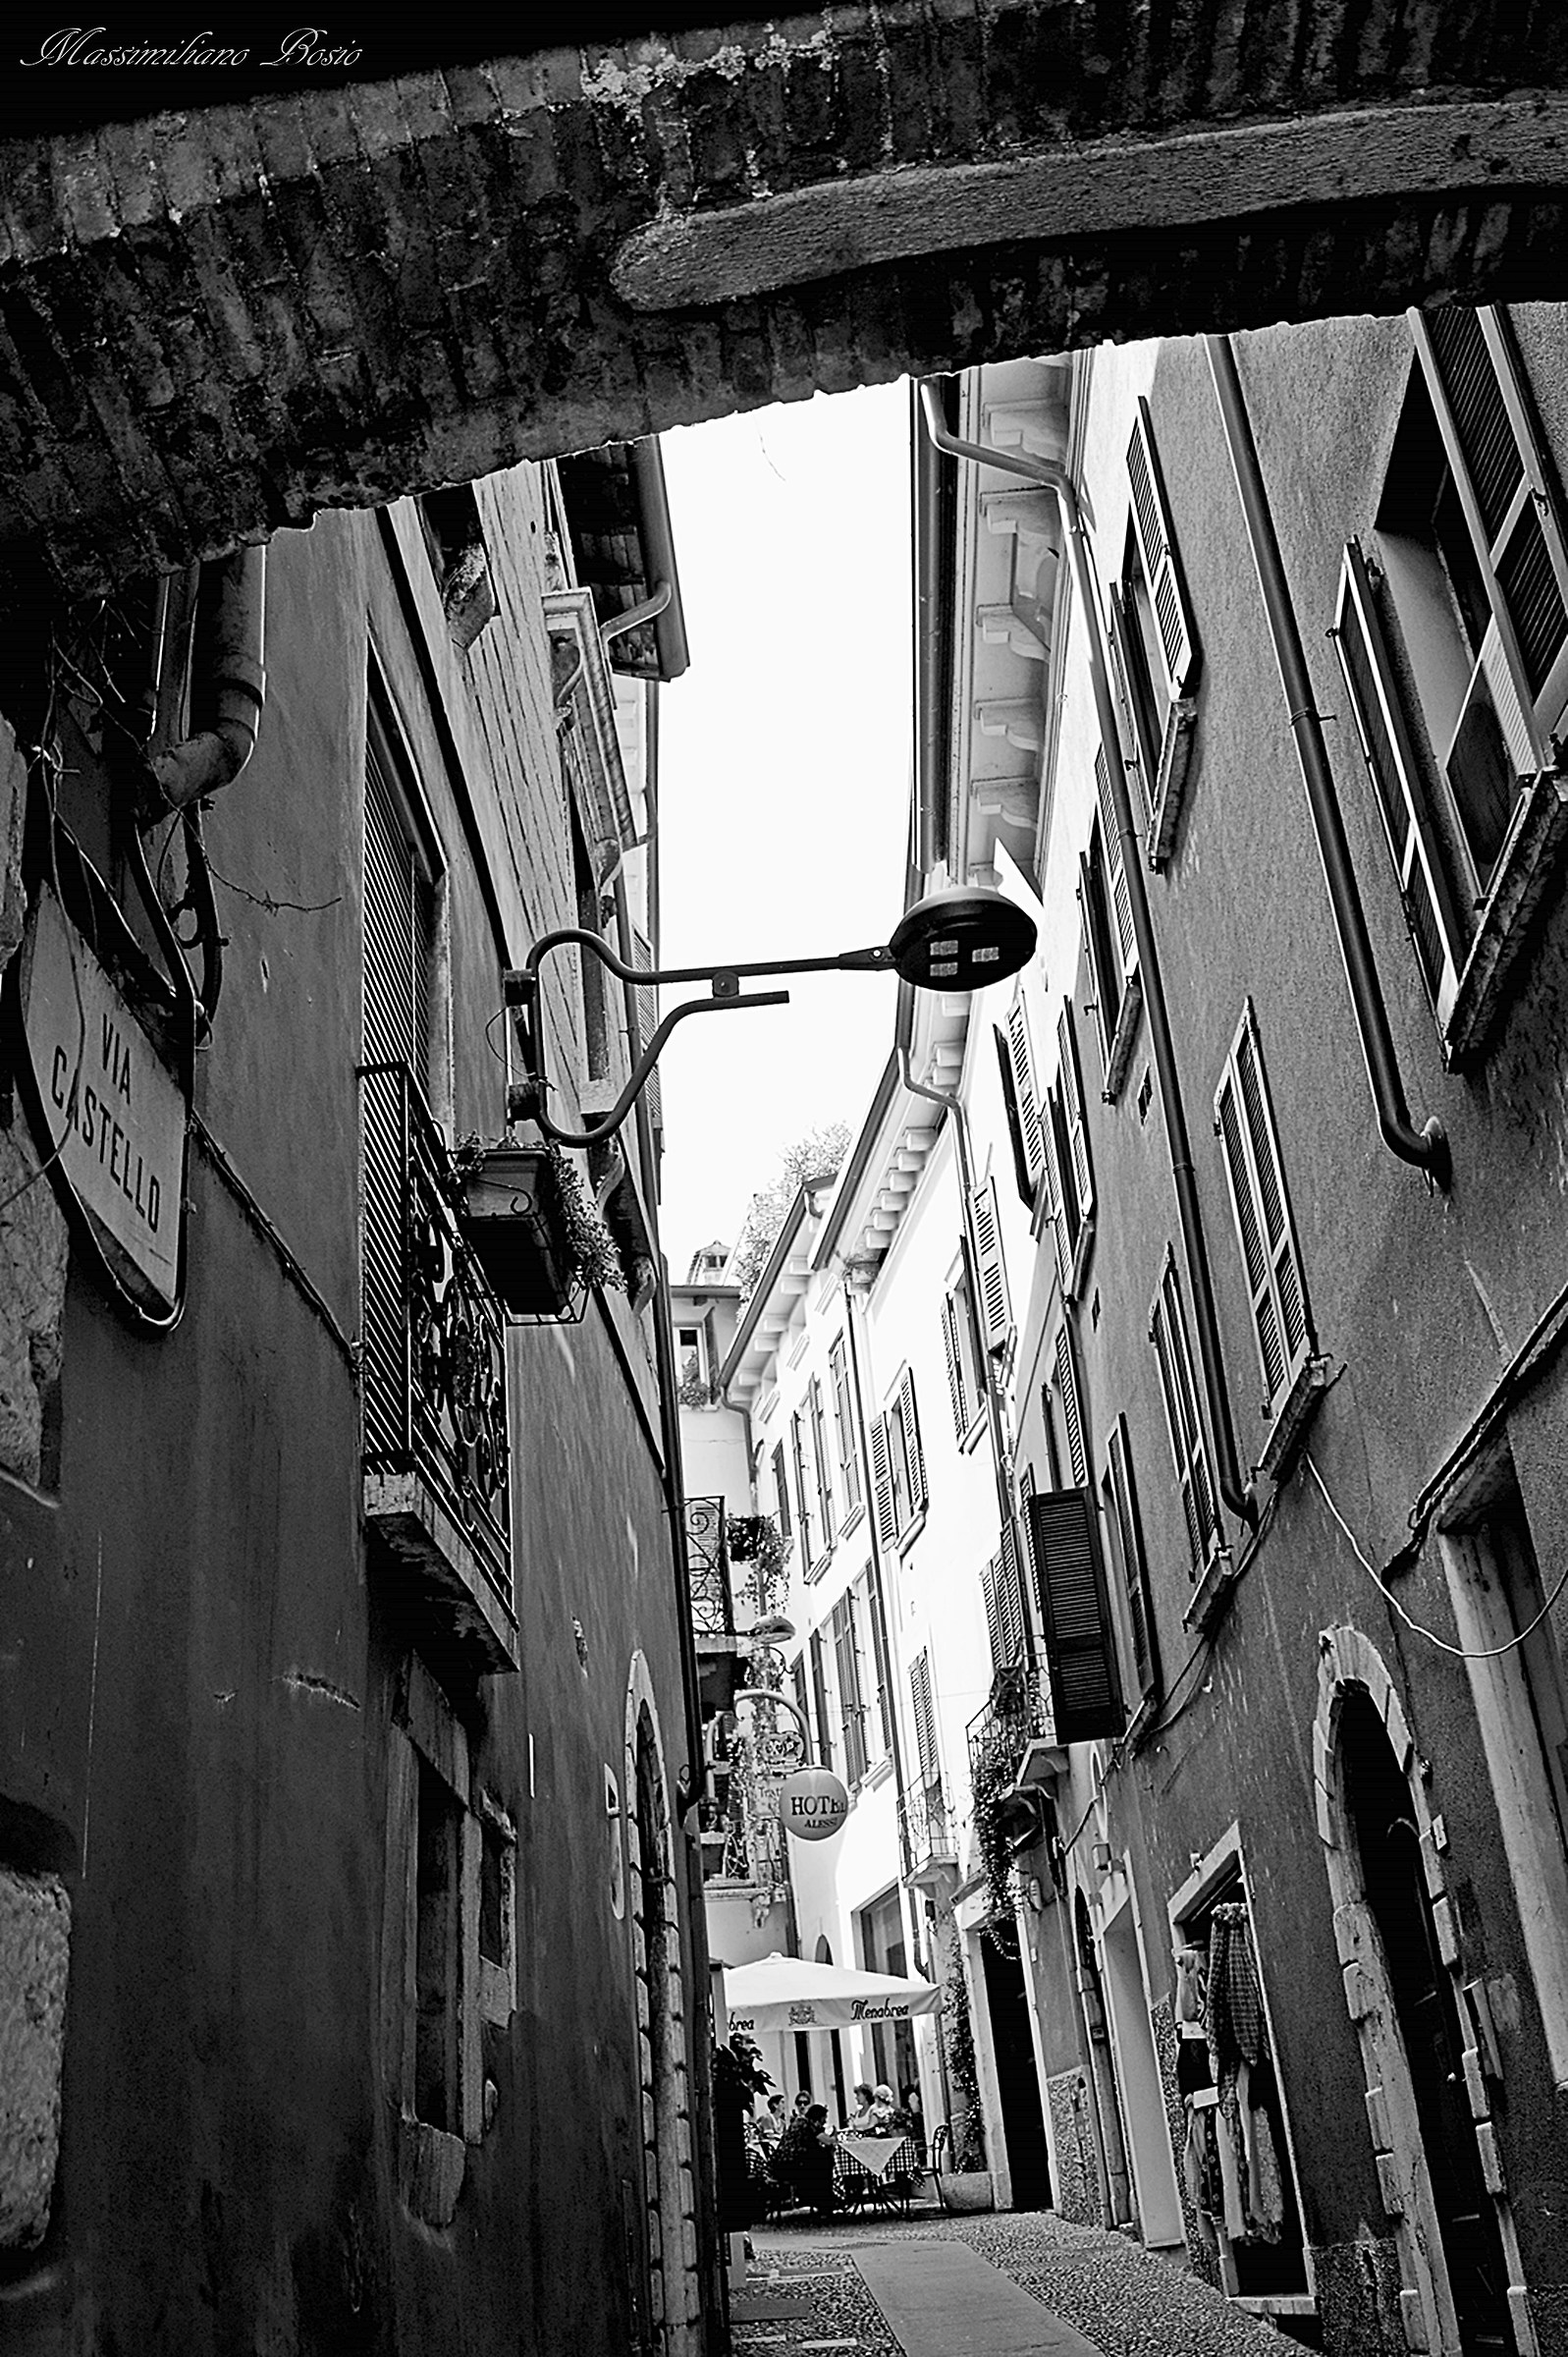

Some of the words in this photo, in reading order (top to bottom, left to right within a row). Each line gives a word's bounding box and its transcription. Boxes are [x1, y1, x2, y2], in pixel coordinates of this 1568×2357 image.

[102, 1013, 131, 1105] VIA
[52, 1045, 160, 1233] CASTELLO
[790, 1795, 846, 1816] HOTEL
[850, 1997, 909, 2020] Menabrea
[728, 2010, 755, 2032] brea
